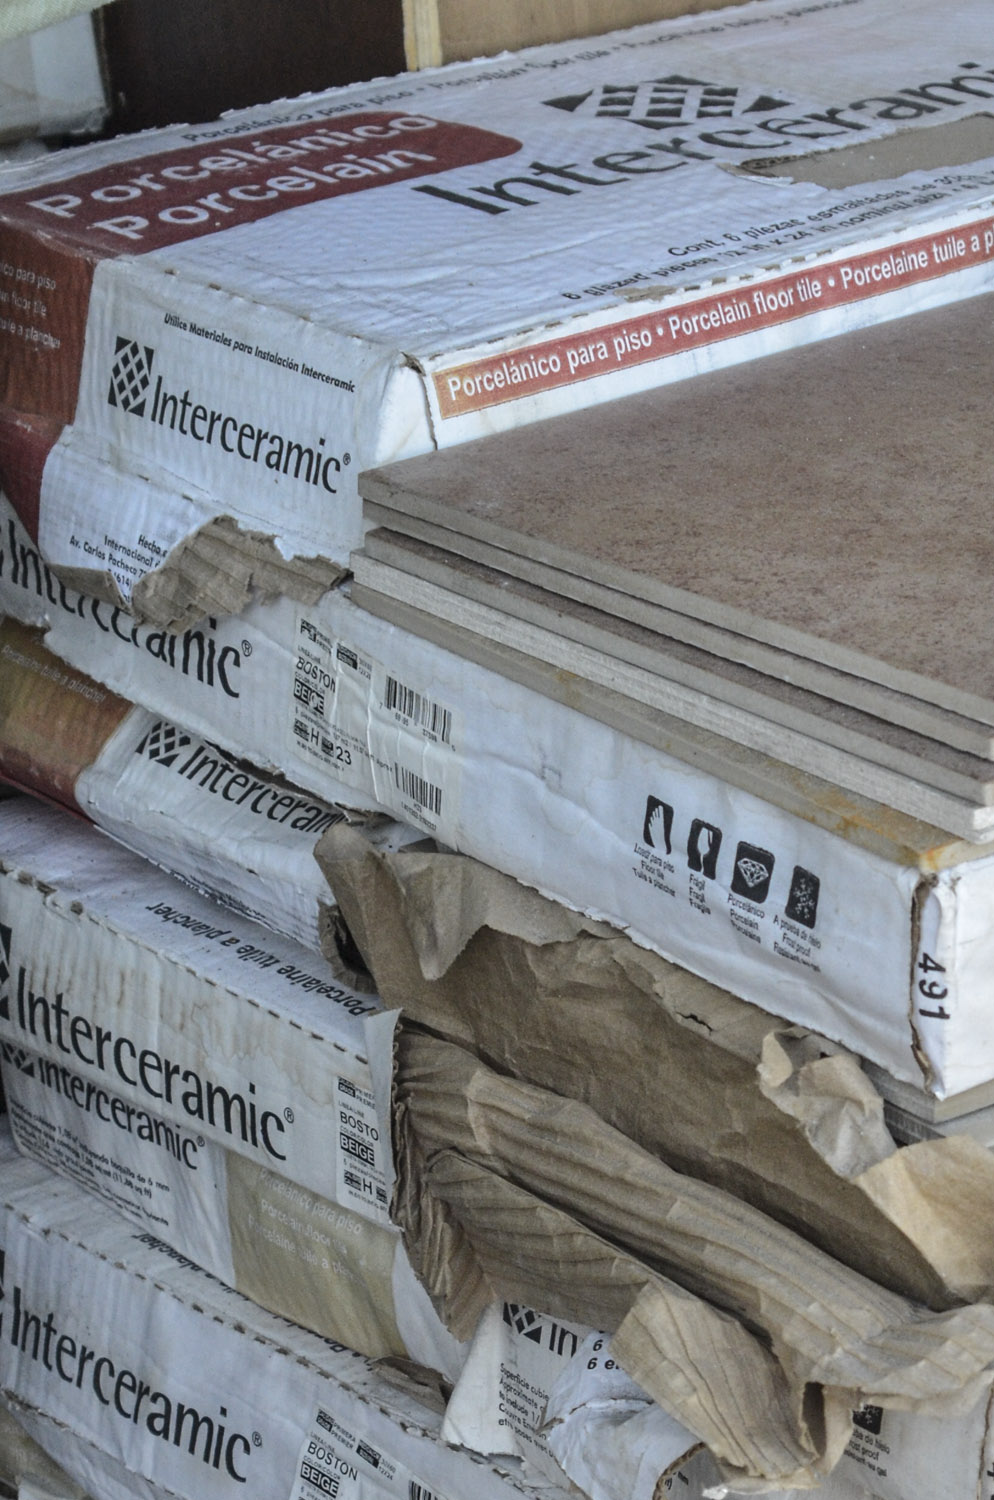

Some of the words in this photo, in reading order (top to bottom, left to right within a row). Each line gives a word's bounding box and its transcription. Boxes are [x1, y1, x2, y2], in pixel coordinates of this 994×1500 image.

[27, 115, 438, 218] Porcelánico
[88, 148, 437, 240] Porcelain
[447, 350, 562, 402] Porcelánico
[566, 340, 610, 375] para
[613, 327, 653, 361] piso
[667, 300, 752, 340] Porcelain
[753, 283, 796, 318] floor
[797, 275, 822, 301] tile
[840, 247, 929, 290] Porcelaine
[932, 233, 967, 265] tuile
[164, 313, 188, 332] Utilice
[189, 323, 232, 349] Materiales
[233, 339, 253, 356] para
[254, 345, 299, 373] Instalación
[301, 362, 356, 394] Interceramic
[83, 541, 106, 561] Carlos
[104, 535, 154, 568] Internacional
[296, 656, 337, 694] BOSTON
[336, 745, 353, 766] 23
[146, 901, 227, 942] plancher
[276, 963, 374, 1018] Porcelaine
[917, 951, 952, 1022] 491
[340, 1136, 375, 1164] BEIGE
[300, 1462, 340, 1499] BEIGE
[307, 1440, 359, 1482] BOSTON
